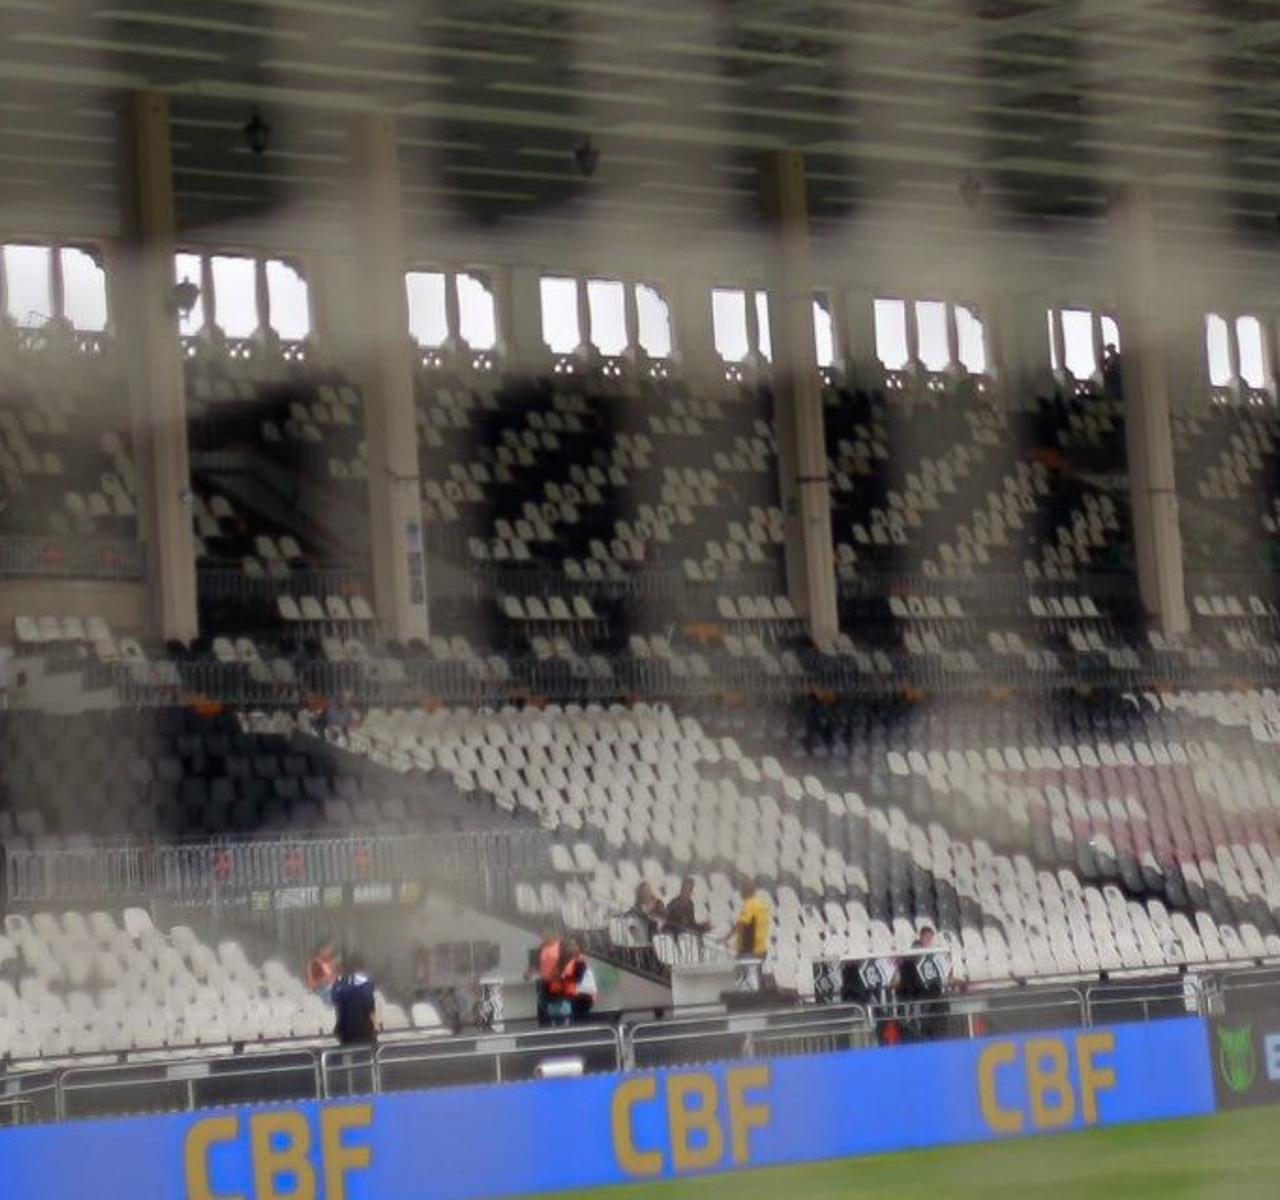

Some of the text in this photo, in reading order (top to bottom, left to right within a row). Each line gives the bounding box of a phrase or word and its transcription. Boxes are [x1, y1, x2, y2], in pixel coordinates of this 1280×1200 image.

[611, 1066, 772, 1177] CBF
[977, 1032, 1117, 1135] CBF
[183, 1105, 376, 1200] CBF
